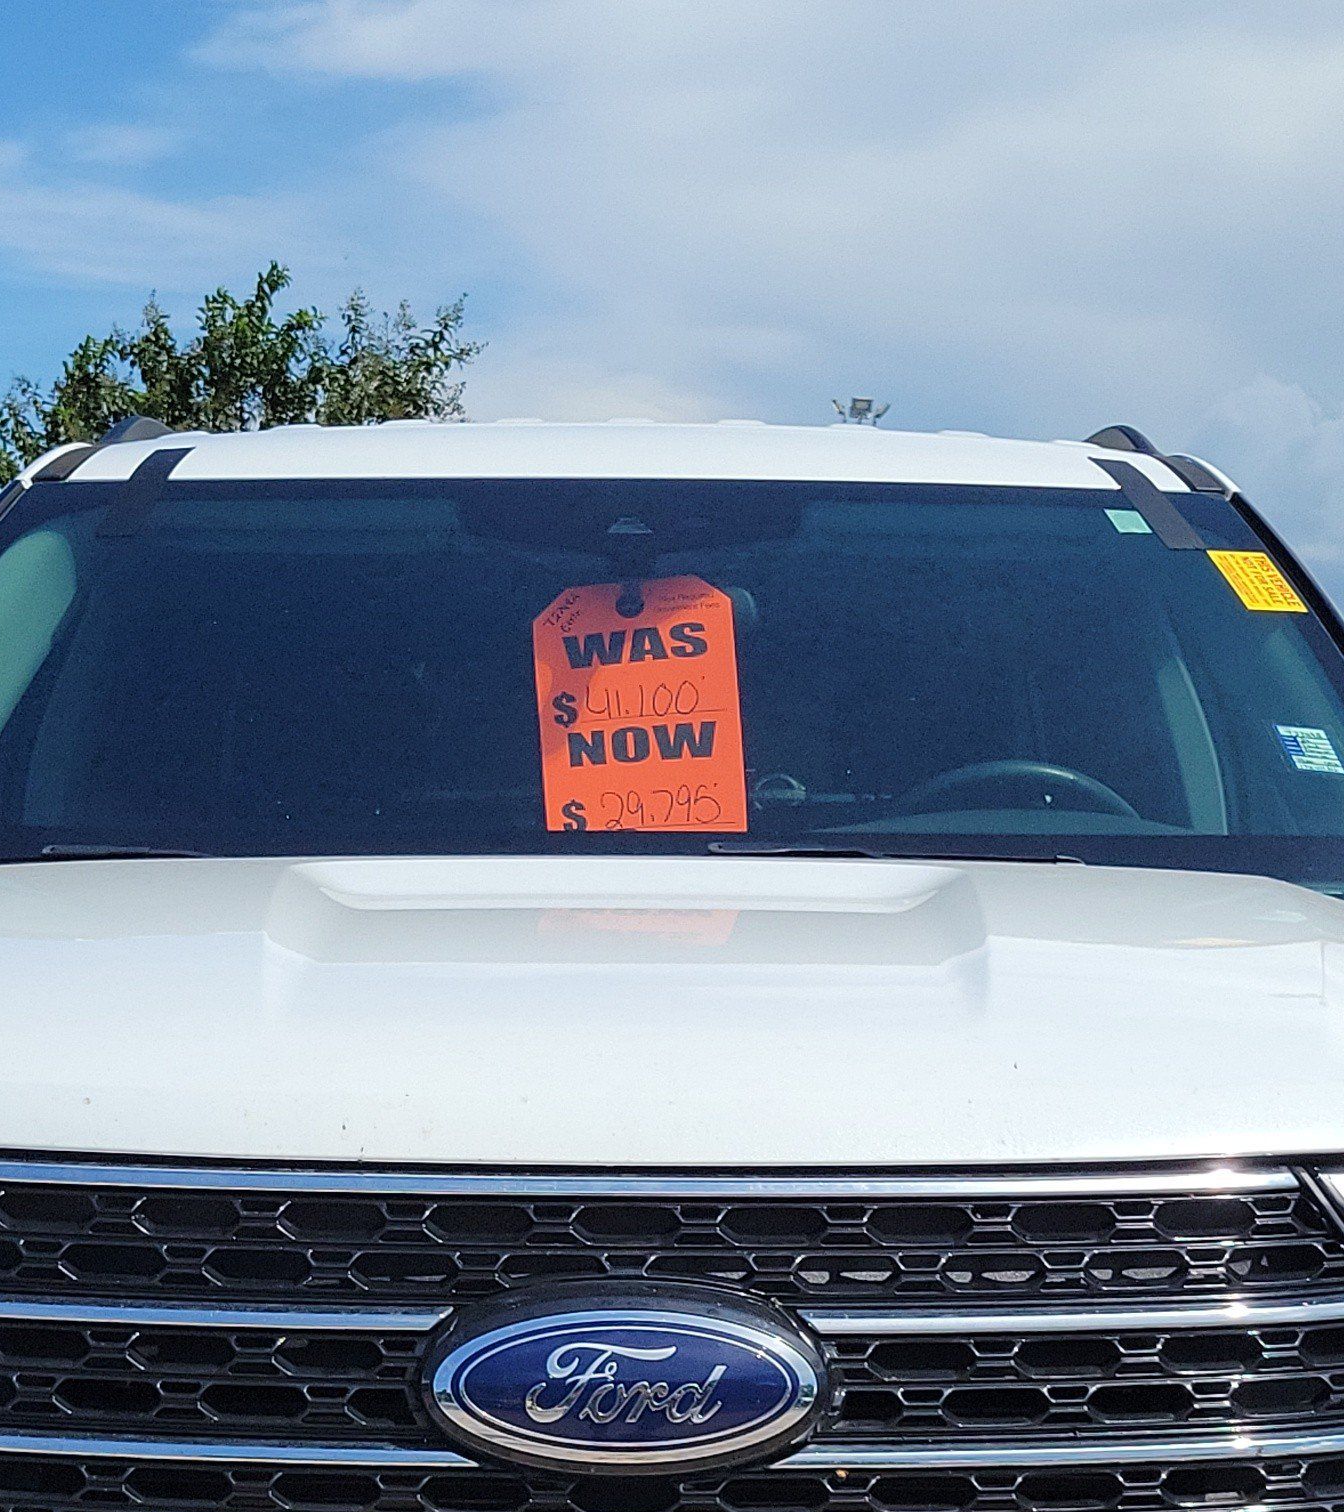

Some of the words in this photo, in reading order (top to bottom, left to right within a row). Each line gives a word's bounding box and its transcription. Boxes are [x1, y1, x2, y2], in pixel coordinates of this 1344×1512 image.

[562, 622, 708, 670] WAS
[552, 691, 578, 728] $
[567, 721, 717, 768] NOW
[561, 799, 587, 831] $
[525, 1341, 728, 1424] Ford
